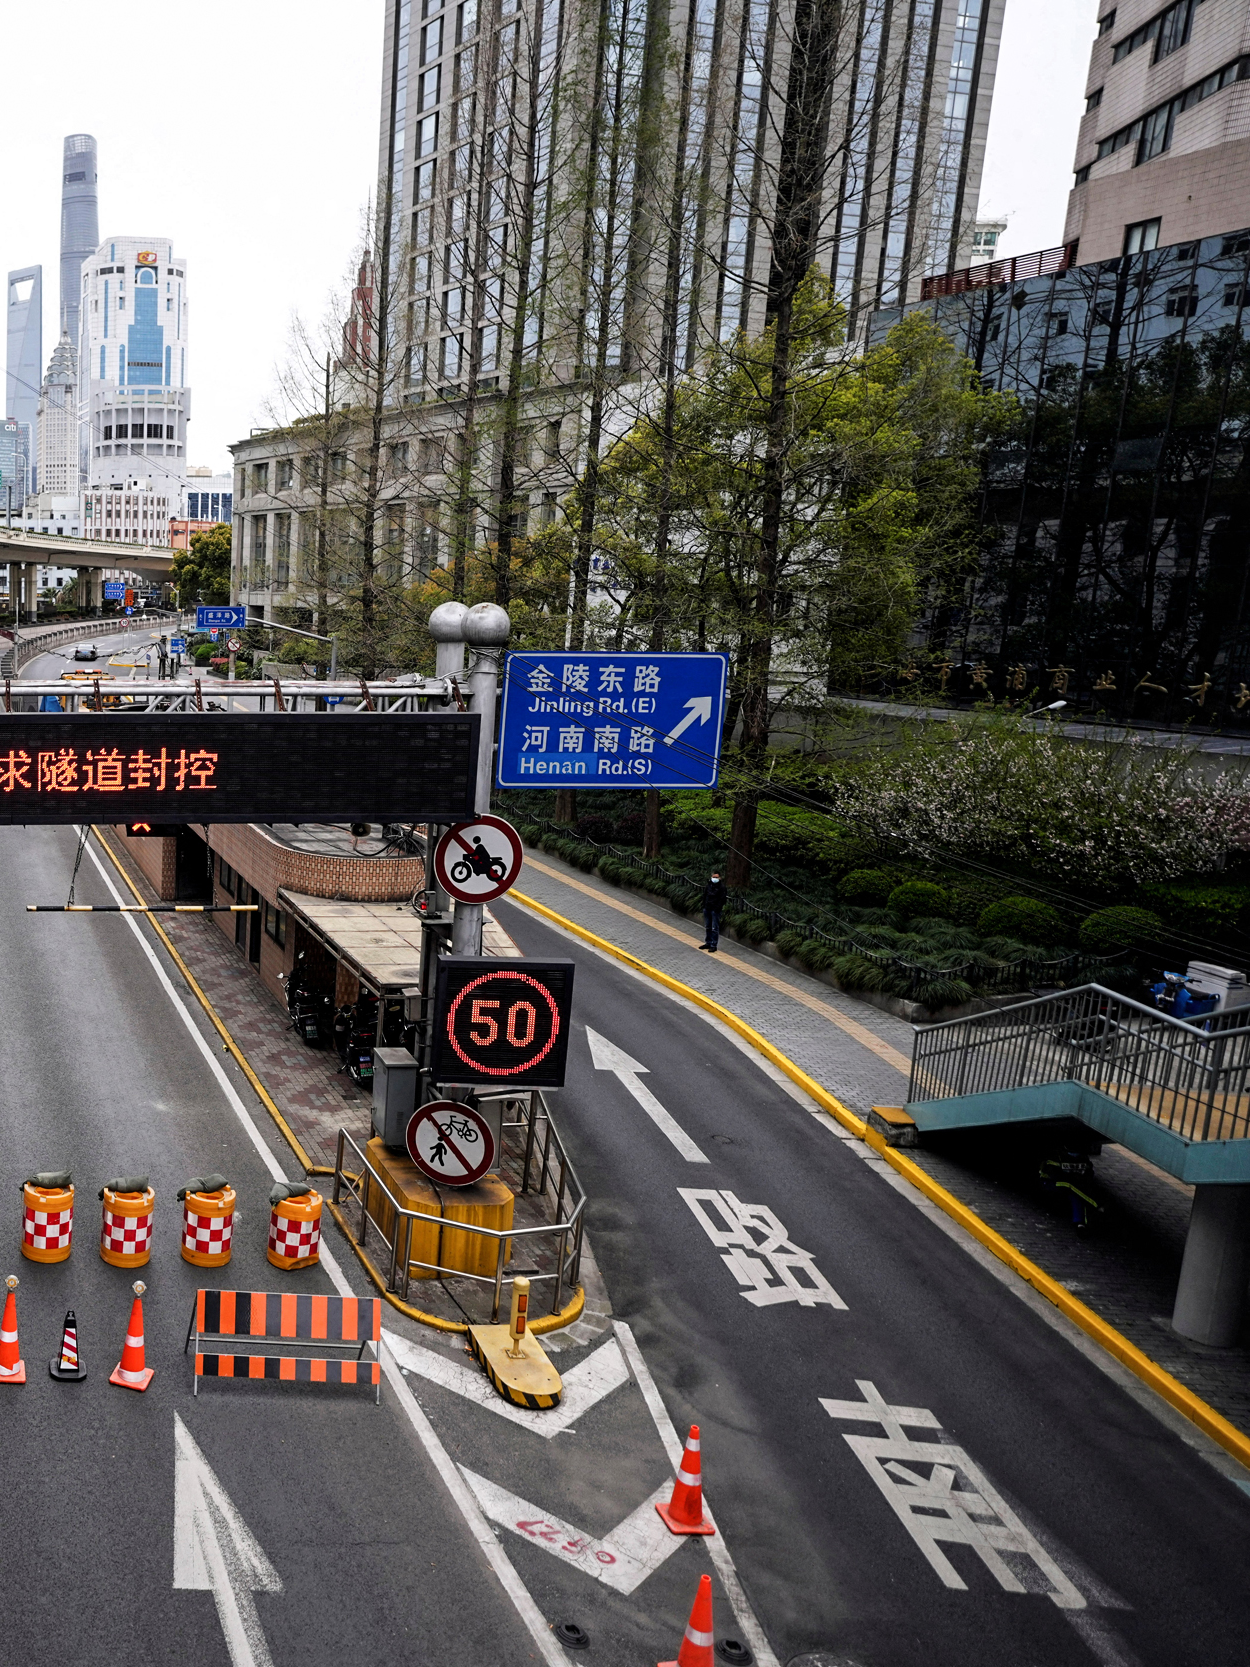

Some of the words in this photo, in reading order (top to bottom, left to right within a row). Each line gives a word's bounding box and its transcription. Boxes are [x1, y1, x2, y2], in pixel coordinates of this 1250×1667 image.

[527, 664, 661, 693] 金陵东路
[528, 697, 594, 716] Jinling
[521, 725, 657, 753] 河南南路
[520, 757, 586, 774] Henan
[470, 1000, 536, 1047] 50
